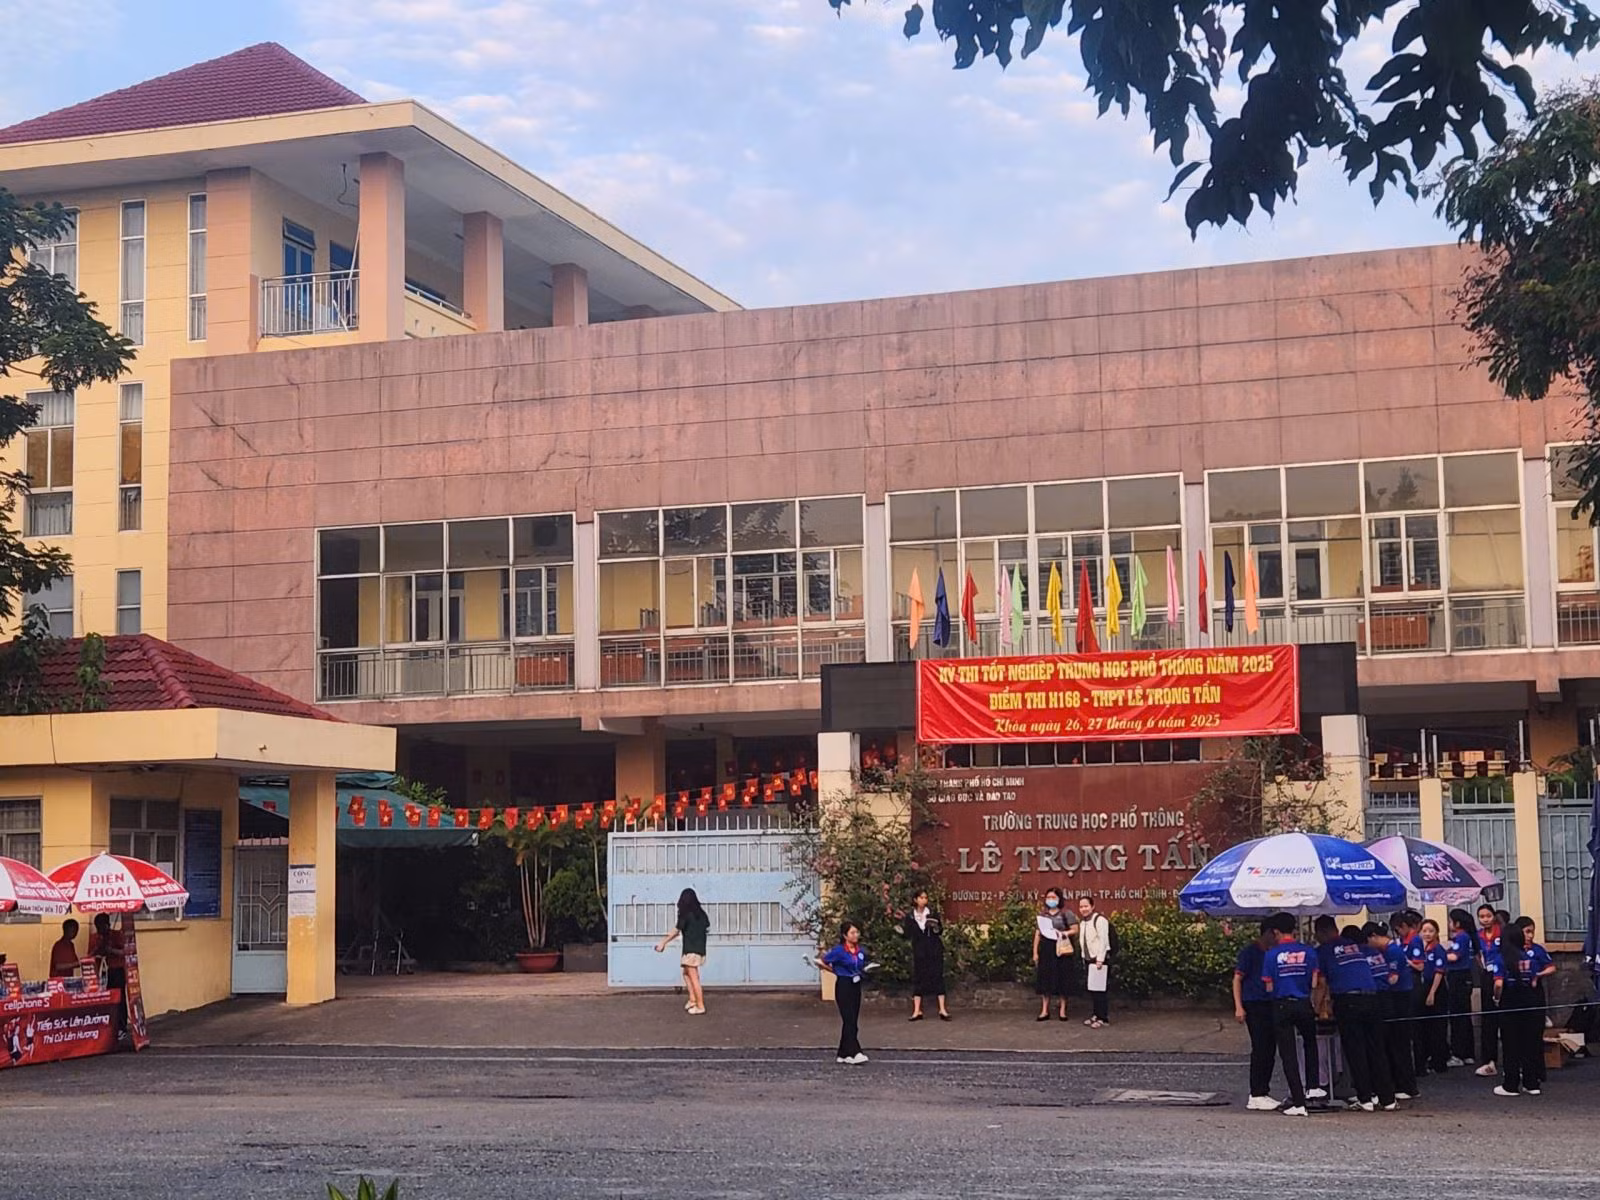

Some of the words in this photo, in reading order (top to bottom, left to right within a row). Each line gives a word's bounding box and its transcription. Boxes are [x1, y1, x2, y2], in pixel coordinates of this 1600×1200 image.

[957, 666, 979, 683] THI
[981, 659, 1006, 682] TỐT
[1008, 661, 1054, 684] NGHIỆP
[1057, 662, 1100, 680] TRUNG
[1103, 660, 1128, 681] HỌC
[1130, 653, 1157, 678] PHỔ
[1159, 656, 1203, 676] THÔNG
[1206, 654, 1239, 675] NĂM
[1242, 655, 1274, 673] 2025
[989, 686, 1023, 711] ĐIỂM
[1025, 692, 1046, 709] THI
[1049, 691, 1081, 709] H168
[1091, 689, 1125, 707] THPT
[1127, 684, 1144, 706] LÊ
[1146, 686, 1190, 708] TRỌNG
[1193, 680, 1221, 704] TẤN
[1030, 720, 1061, 735] ngày
[1065, 719, 1084, 732] 26,
[1087, 718, 1103, 731] 27
[1106, 716, 1142, 732] tháng
[1148, 716, 1156, 729] 6
[1158, 717, 1186, 728] năm
[1190, 714, 1220, 728] 2025
[1005, 776, 1025, 787] MINH
[983, 809, 1032, 831] TRƯỜNG
[1036, 812, 1078, 830] TRUNG
[1081, 812, 1108, 833] HỌC
[1111, 804, 1138, 829] PHỔ
[1141, 807, 1185, 828] THÔNG
[957, 840, 1003, 874] LÊ
[1014, 843, 1128, 877] TRỌNG
[1137, 830, 1211, 871] TẤN
[90, 872, 125, 886] ĐIỆN
[85, 886, 131, 899] THOẠI
[981, 890, 993, 901] D2
